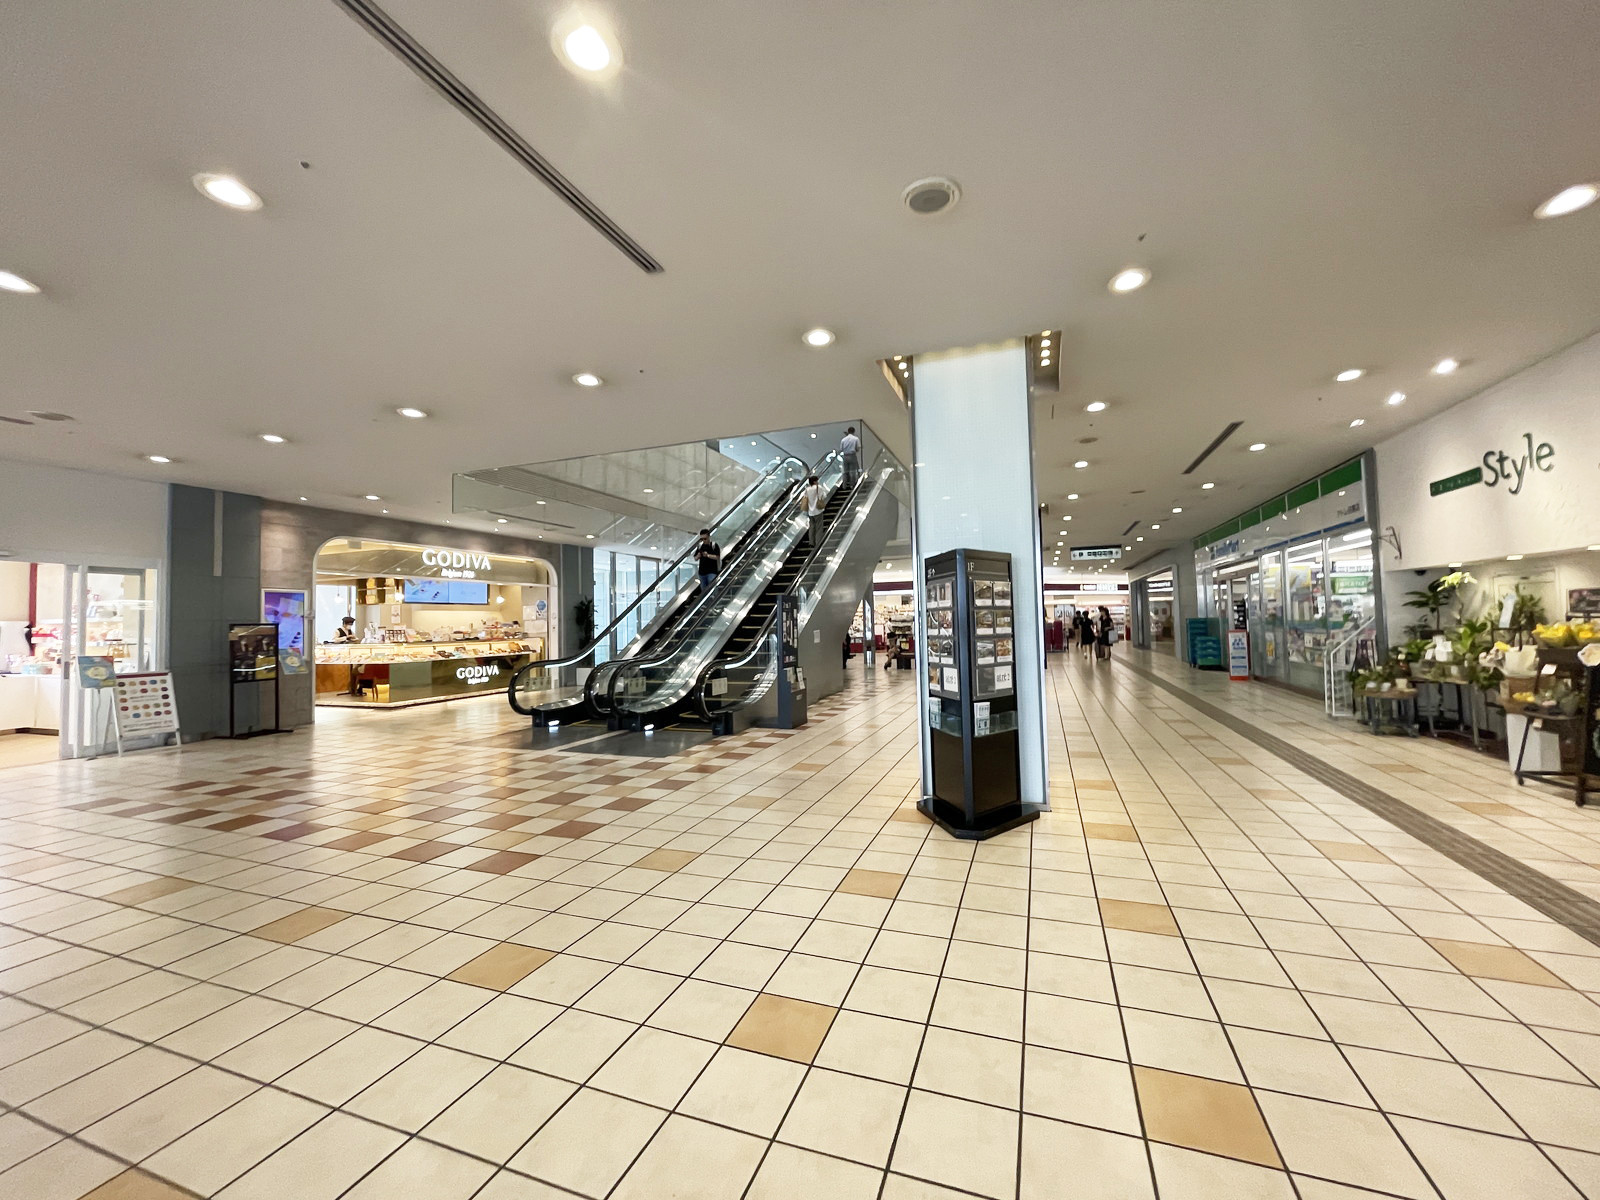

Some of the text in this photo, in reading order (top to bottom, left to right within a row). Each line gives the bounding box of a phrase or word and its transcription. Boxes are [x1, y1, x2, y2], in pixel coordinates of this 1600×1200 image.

[1483, 432, 1555, 495] Style
[422, 549, 491, 570] GODIVA
[456, 665, 499, 679] GODIVA
